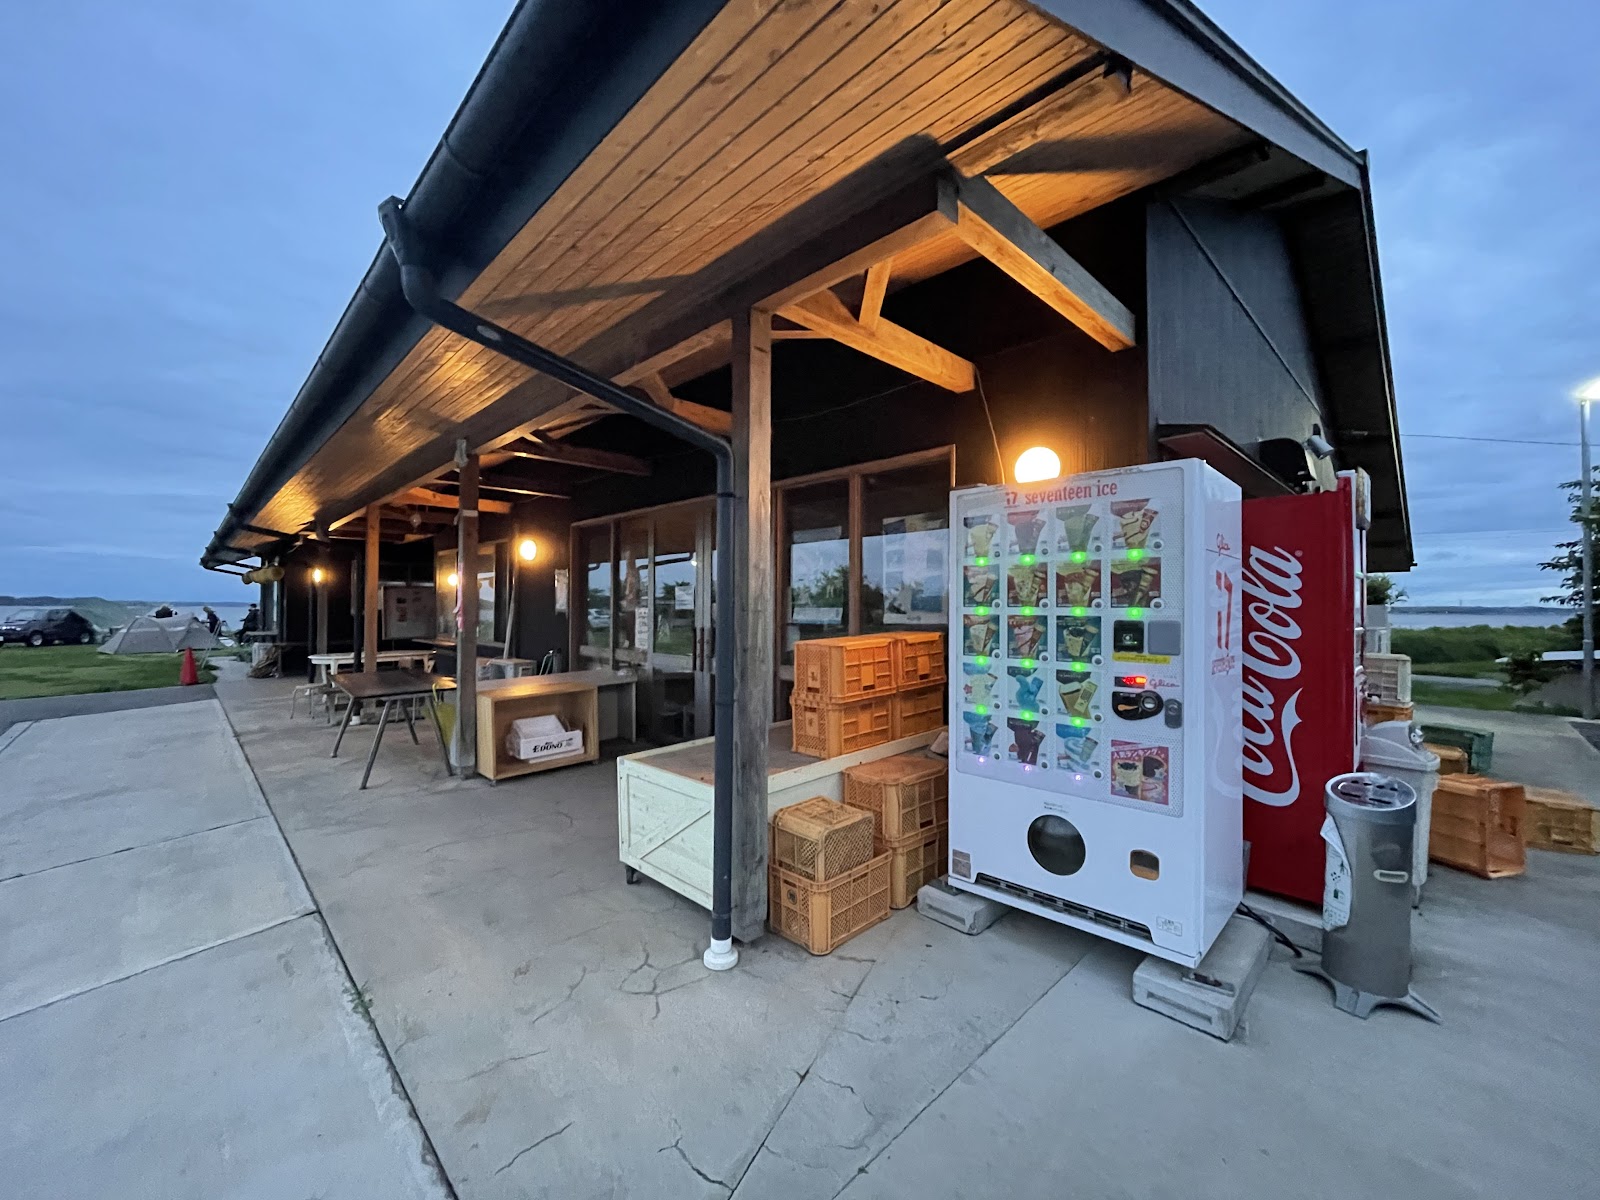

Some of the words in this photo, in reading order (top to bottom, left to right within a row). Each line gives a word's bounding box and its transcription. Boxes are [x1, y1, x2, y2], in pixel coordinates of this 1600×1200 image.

[1024, 485, 1092, 505] seventeen
[1096, 480, 1118, 497] ice
[1242, 545, 1303, 808] CocaCola
